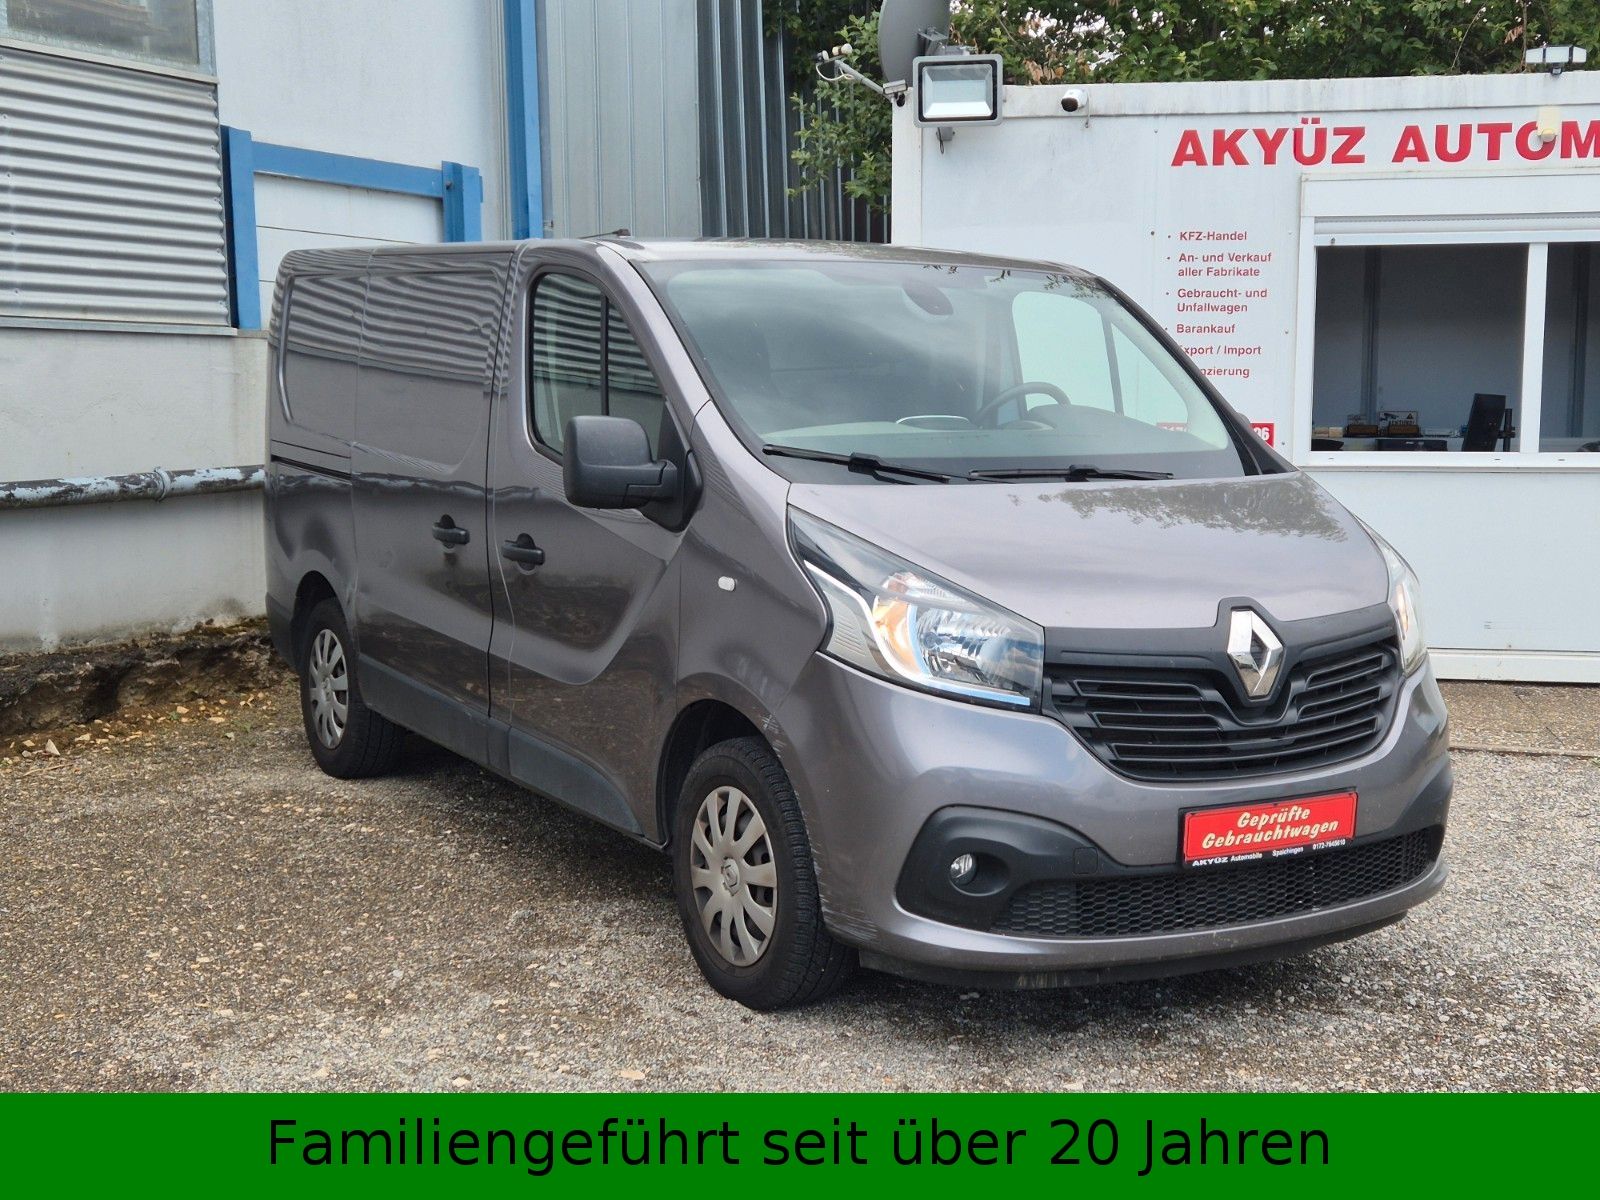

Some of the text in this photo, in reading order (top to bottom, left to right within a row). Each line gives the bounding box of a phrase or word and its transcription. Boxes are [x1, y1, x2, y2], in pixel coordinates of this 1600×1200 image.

[1171, 117, 1366, 167] AKYÜZ
[1179, 231, 1247, 241] KFZ-Handel
[1178, 252, 1272, 262] An- und Verkauf
[1178, 267, 1261, 276] aller Fabrikate
[1177, 288, 1268, 298] Gebraucht- und
[1177, 302, 1248, 315] Unfallwagen
[1176, 323, 1236, 334] Barankauf
[1181, 345, 1213, 357] xport
[1224, 345, 1262, 357] Import
[1237, 805, 1311, 830] Geprüfte
[1202, 819, 1339, 849] Gebrauchtwagen
[1192, 856, 1229, 867] AKYÜZ
[1230, 852, 1263, 863] Automobile
